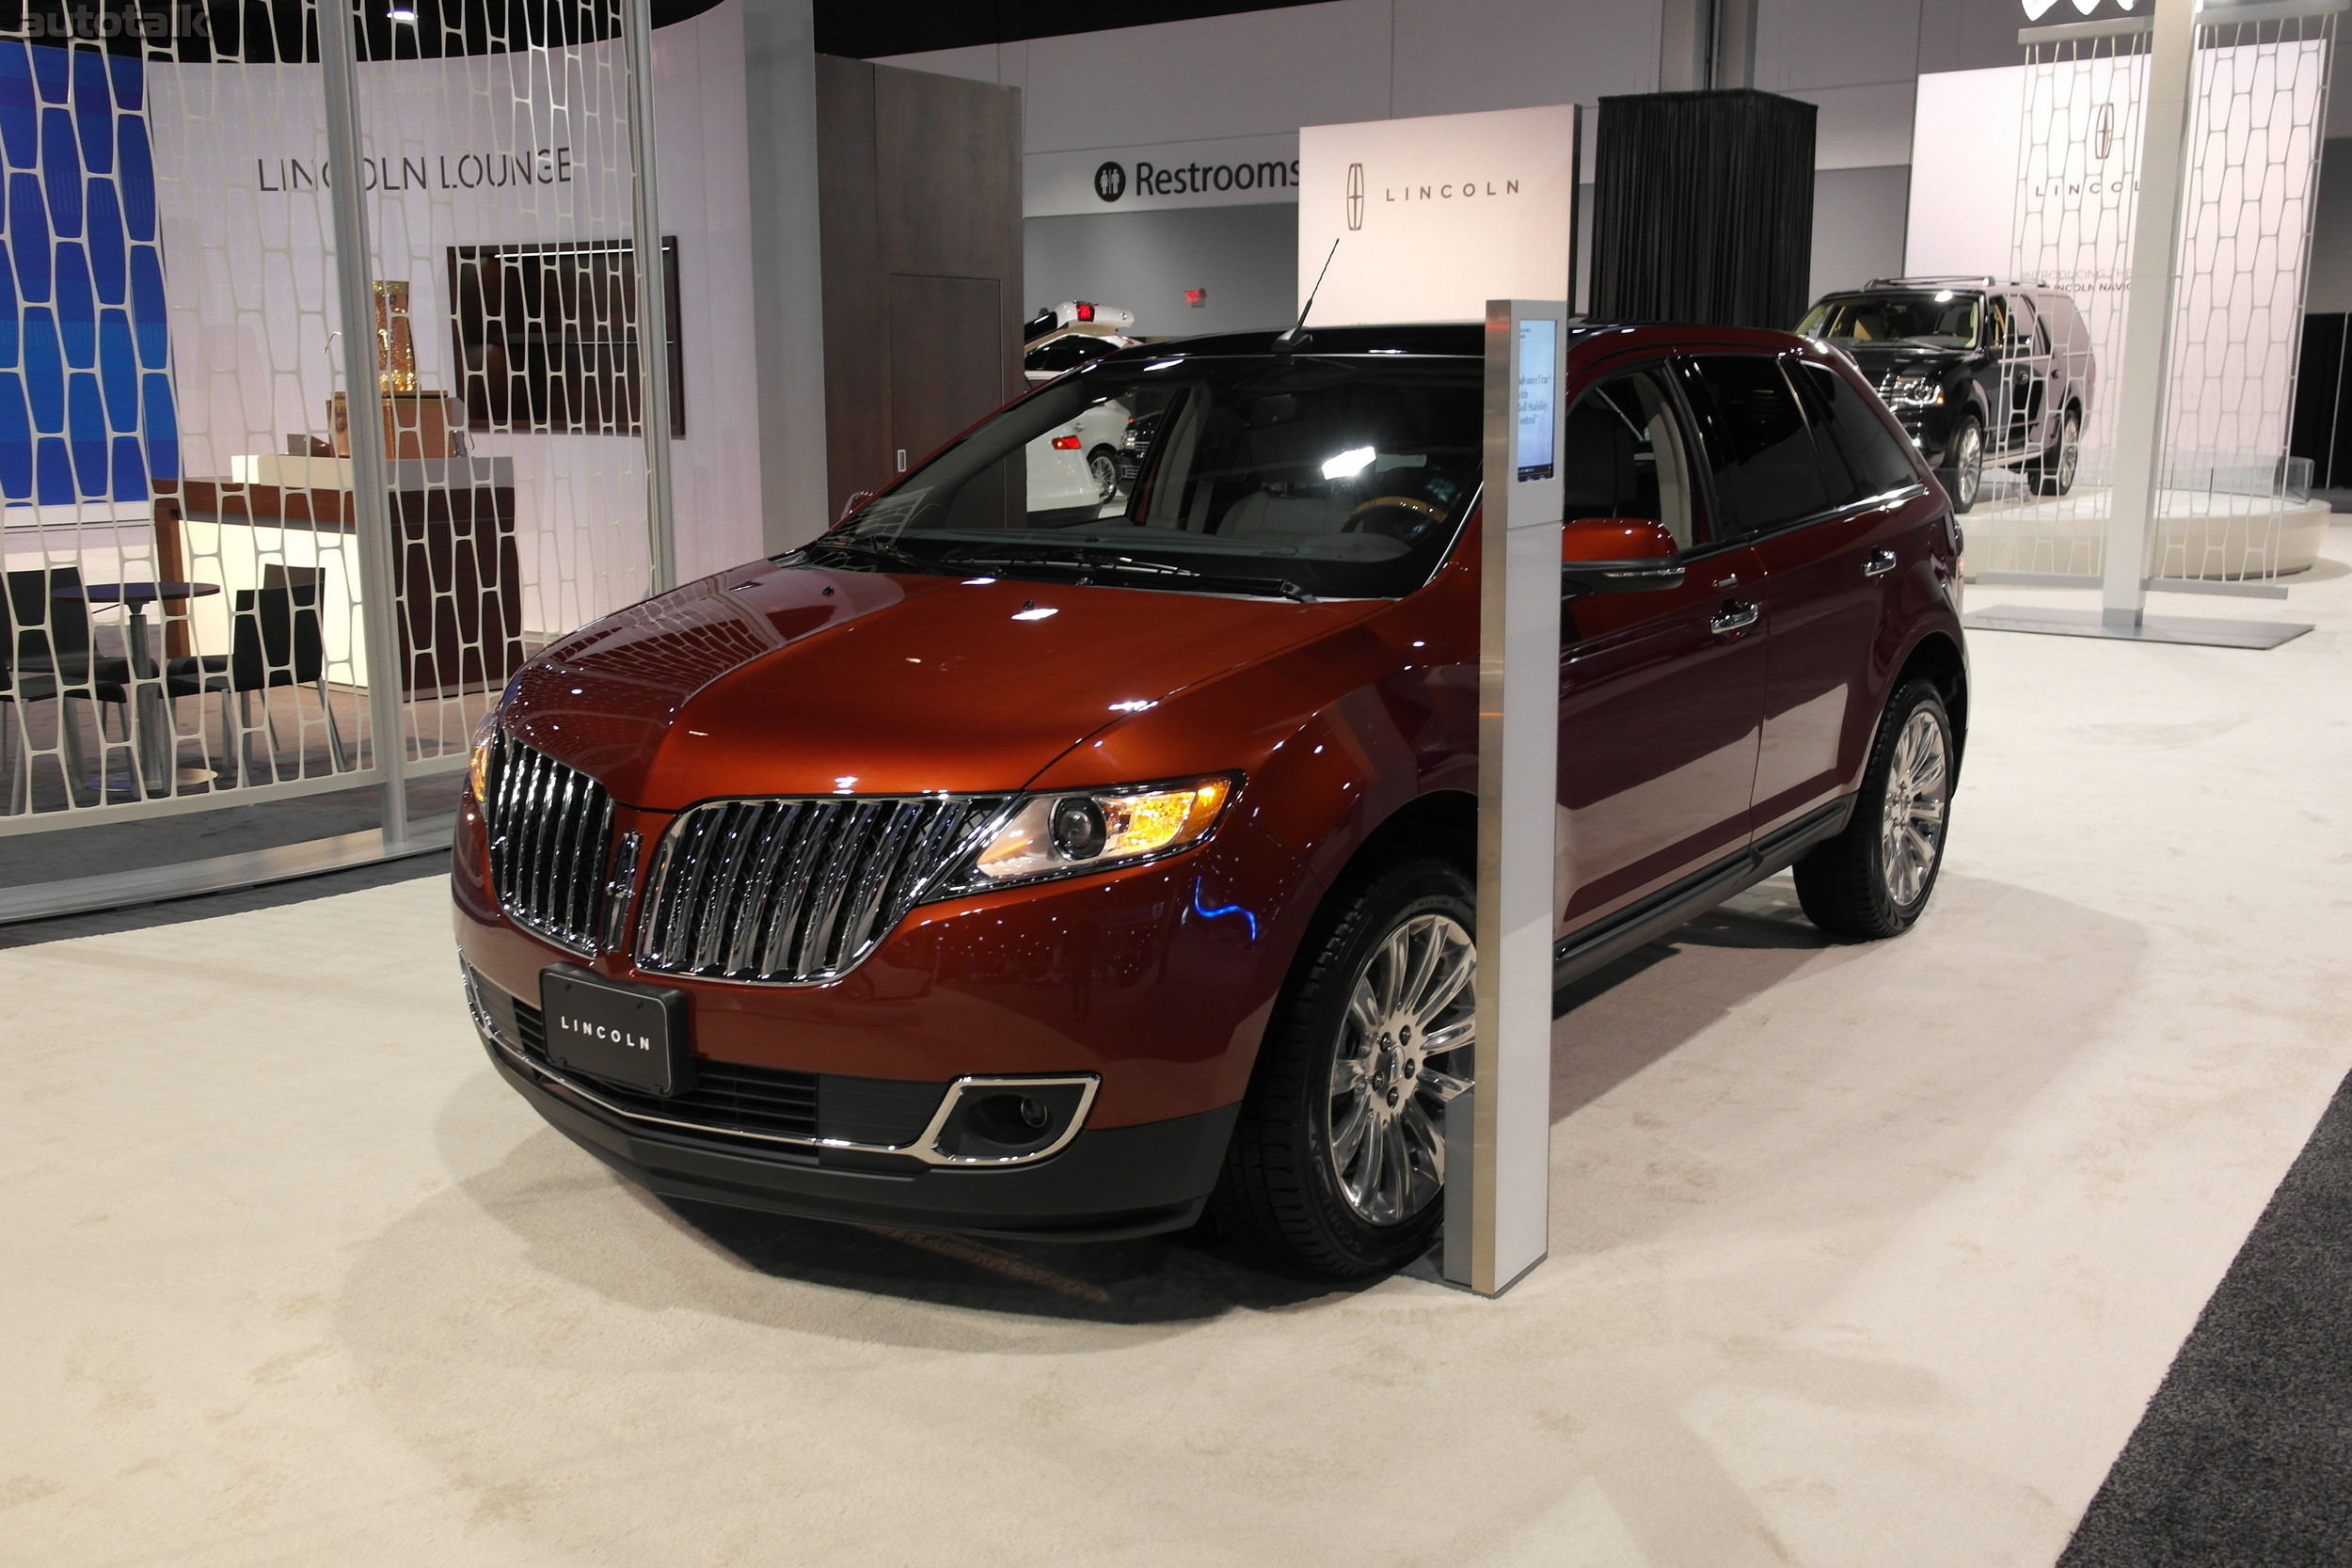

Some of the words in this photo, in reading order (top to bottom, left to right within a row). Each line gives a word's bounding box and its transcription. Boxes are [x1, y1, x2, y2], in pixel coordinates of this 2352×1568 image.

[440, 148, 572, 189] LOUNGE
[1136, 160, 1299, 197] Restrooms
[1386, 180, 1519, 201] LINCOLN
[2035, 181, 2140, 197] LINCOL
[561, 1016, 650, 1051] LINCOLN
